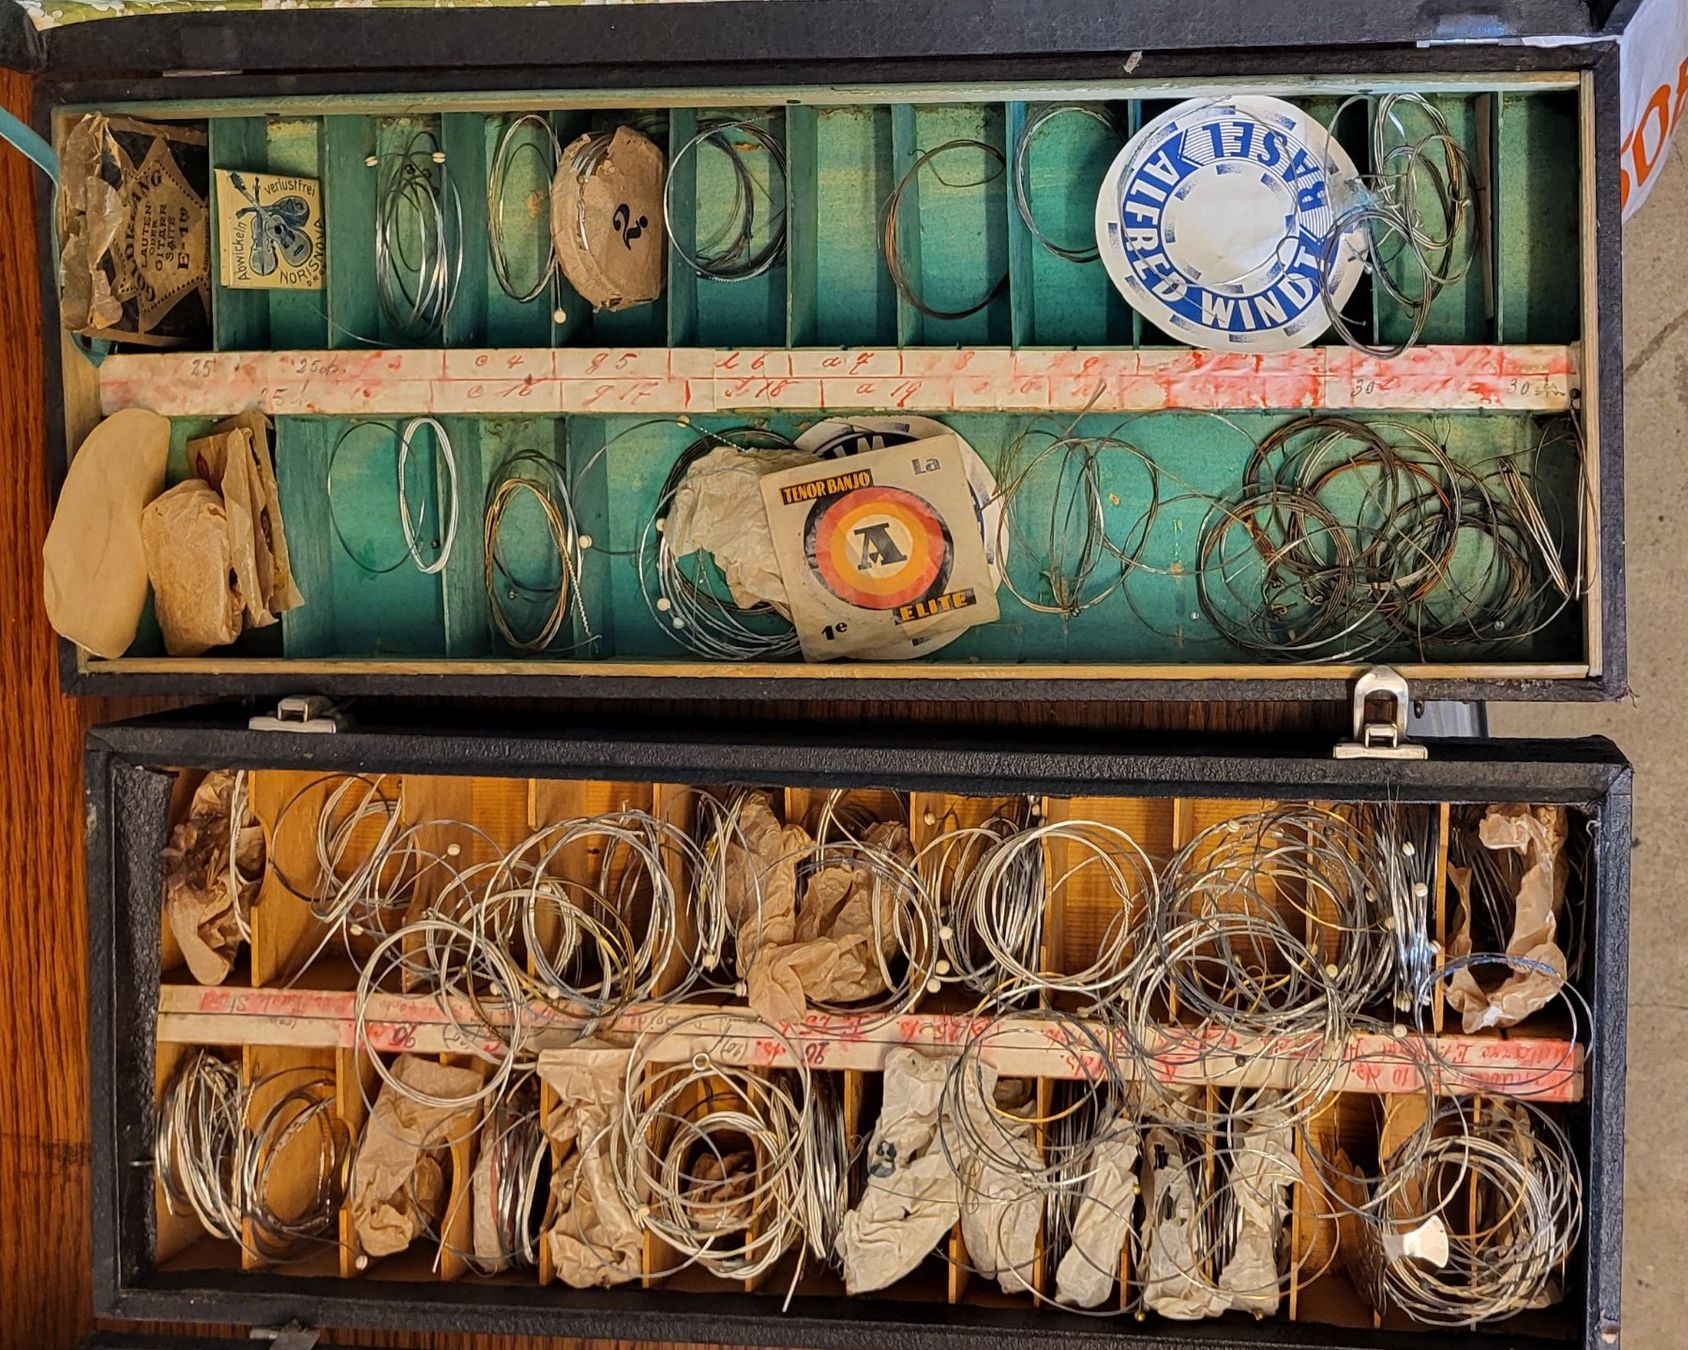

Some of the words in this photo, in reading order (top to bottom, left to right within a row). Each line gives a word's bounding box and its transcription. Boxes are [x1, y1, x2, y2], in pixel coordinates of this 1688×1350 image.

[264, 178, 316, 197] verlustfrei
[1202, 121, 1326, 212] BASEL
[141, 204, 152, 269] LAUTEN
[149, 219, 158, 256] ODER
[155, 204, 167, 271] GITARR
[166, 216, 177, 262] SAITE
[232, 221, 250, 280] Abwickeln
[1124, 151, 1187, 302] ALFRED
[1201, 246, 1331, 329] WINDT
[783, 481, 826, 504] TENOR
[827, 471, 870, 496] BANJO
[911, 456, 941, 475] La
[853, 522, 908, 571] A
[899, 593, 968, 622] ELITE
